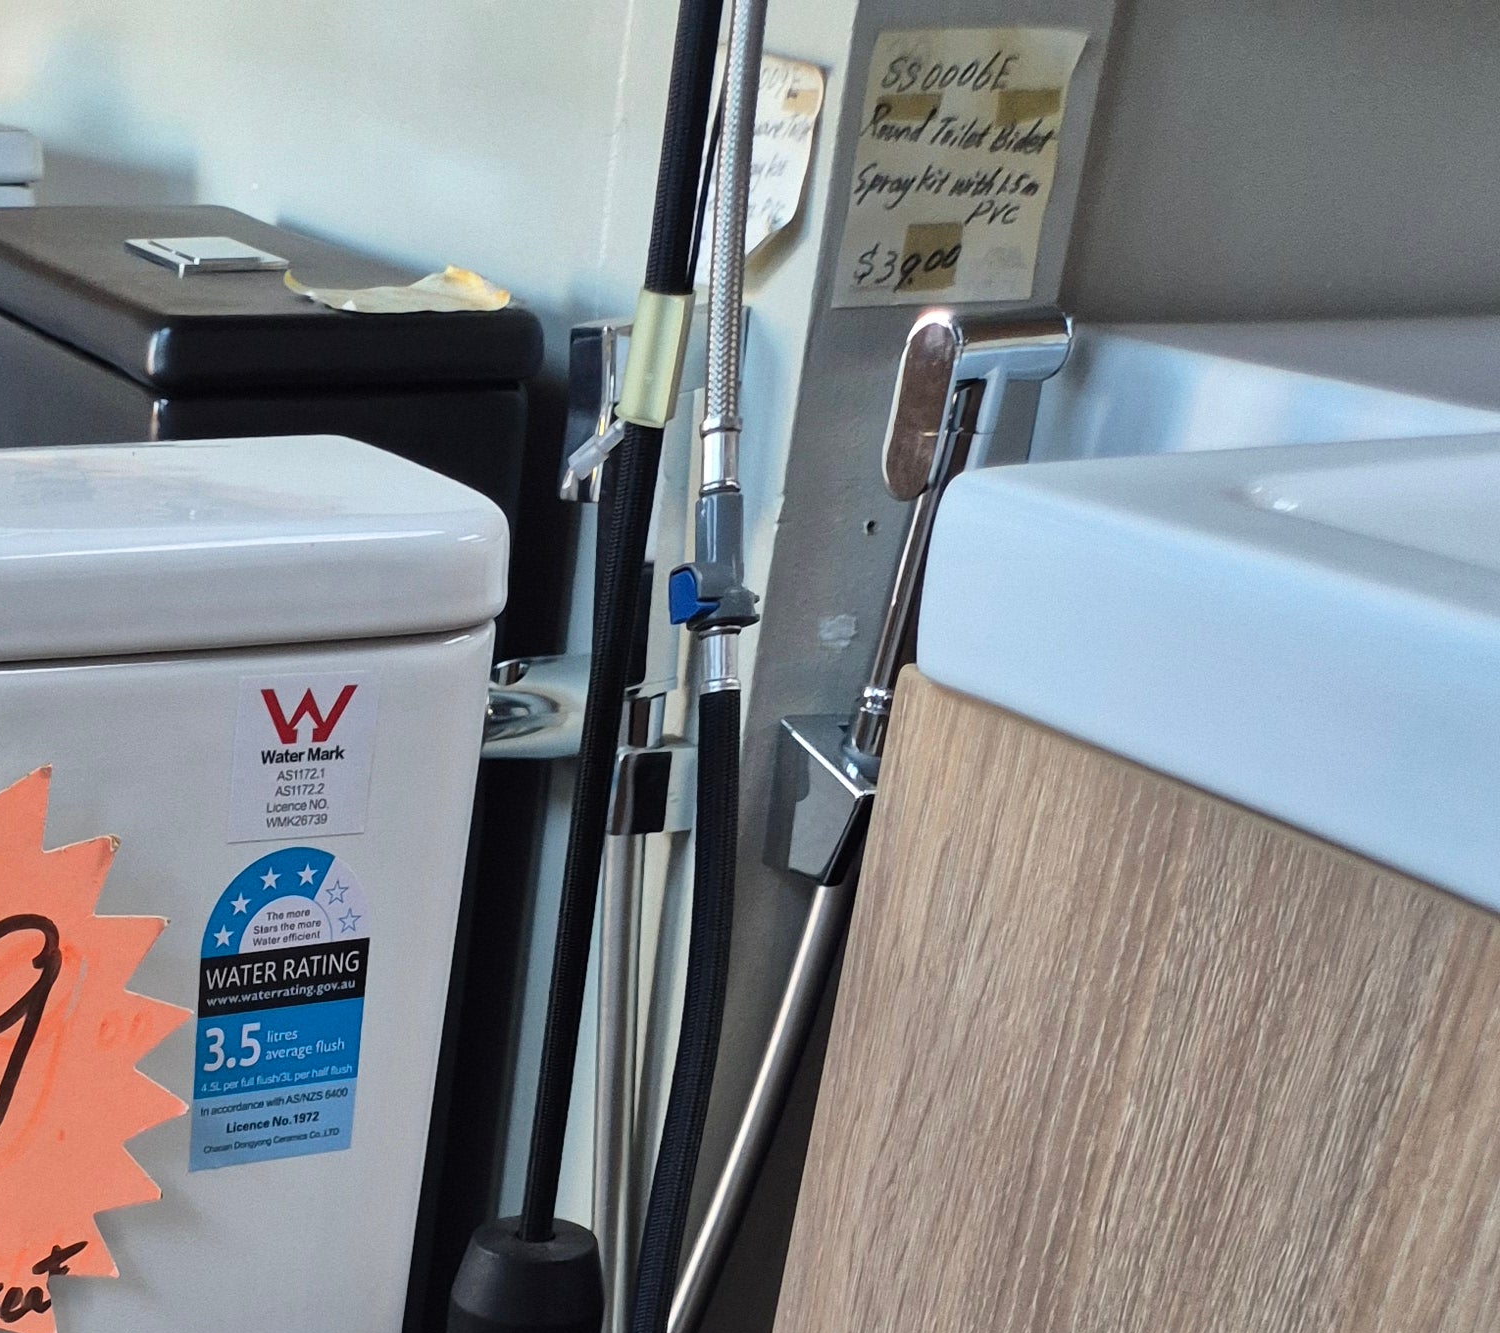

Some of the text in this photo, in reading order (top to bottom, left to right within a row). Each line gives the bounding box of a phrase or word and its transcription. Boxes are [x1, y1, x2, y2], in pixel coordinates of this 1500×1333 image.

[860, 101, 938, 144] Round
[854, 161, 917, 211] Spray
[963, 198, 1021, 227] PVC
[261, 745, 345, 765] Water Mark
[277, 767, 325, 781] AS1172.1
[275, 783, 325, 797] AS1172.2
[266, 801, 307, 814] Licence
[267, 908, 310, 921] The more
[253, 919, 322, 935] Stars the more
[252, 930, 321, 947] Water efficient
[205, 950, 360, 990] WATER RATING
[206, 979, 356, 1007] www.waterrating.gov.au
[266, 1029, 298, 1043] litres
[203, 1021, 261, 1072] 3.5
[265, 1037, 345, 1061] average flush
[226, 1119, 270, 1133] Licence
